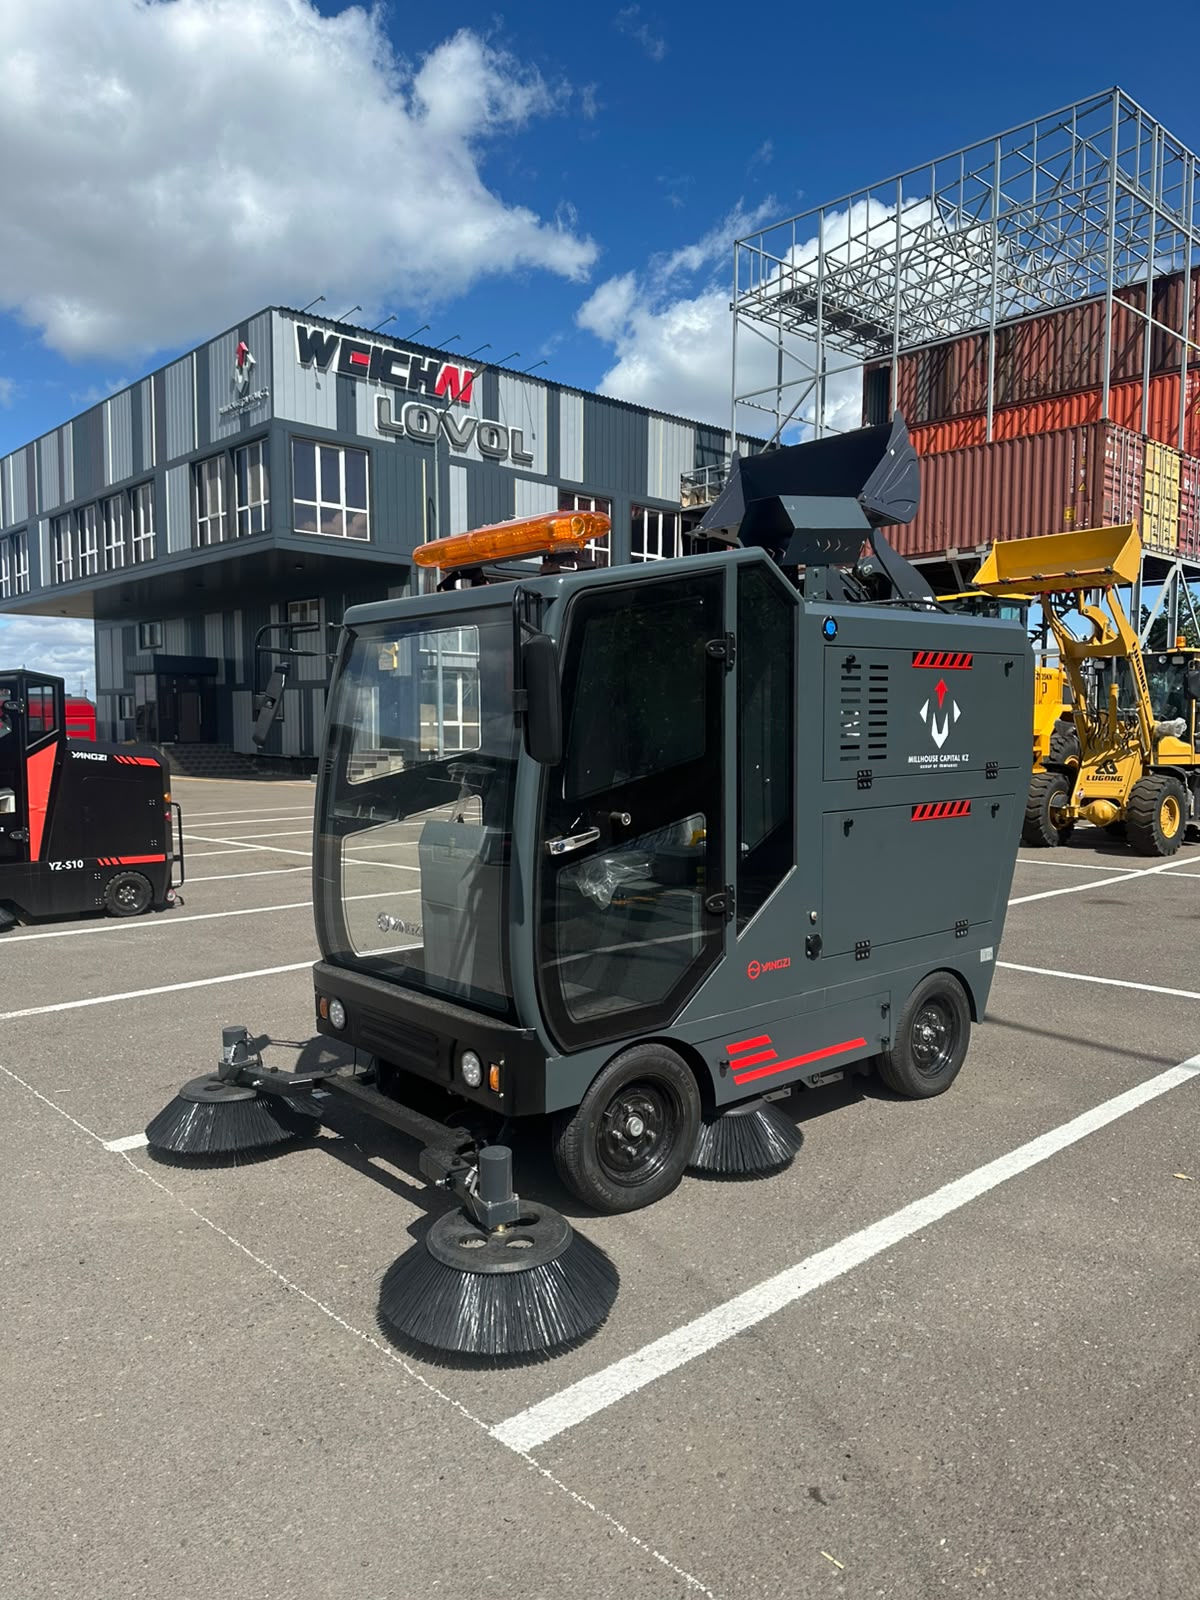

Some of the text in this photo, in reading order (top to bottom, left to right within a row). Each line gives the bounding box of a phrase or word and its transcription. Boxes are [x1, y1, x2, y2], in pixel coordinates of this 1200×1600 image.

[374, 394, 534, 465] LOVOL
[71, 751, 108, 762] YANGZI
[940, 754, 961, 762] CAPITAL
[49, 860, 84, 871] YZ-S10
[761, 957, 791, 972] YANGZI
